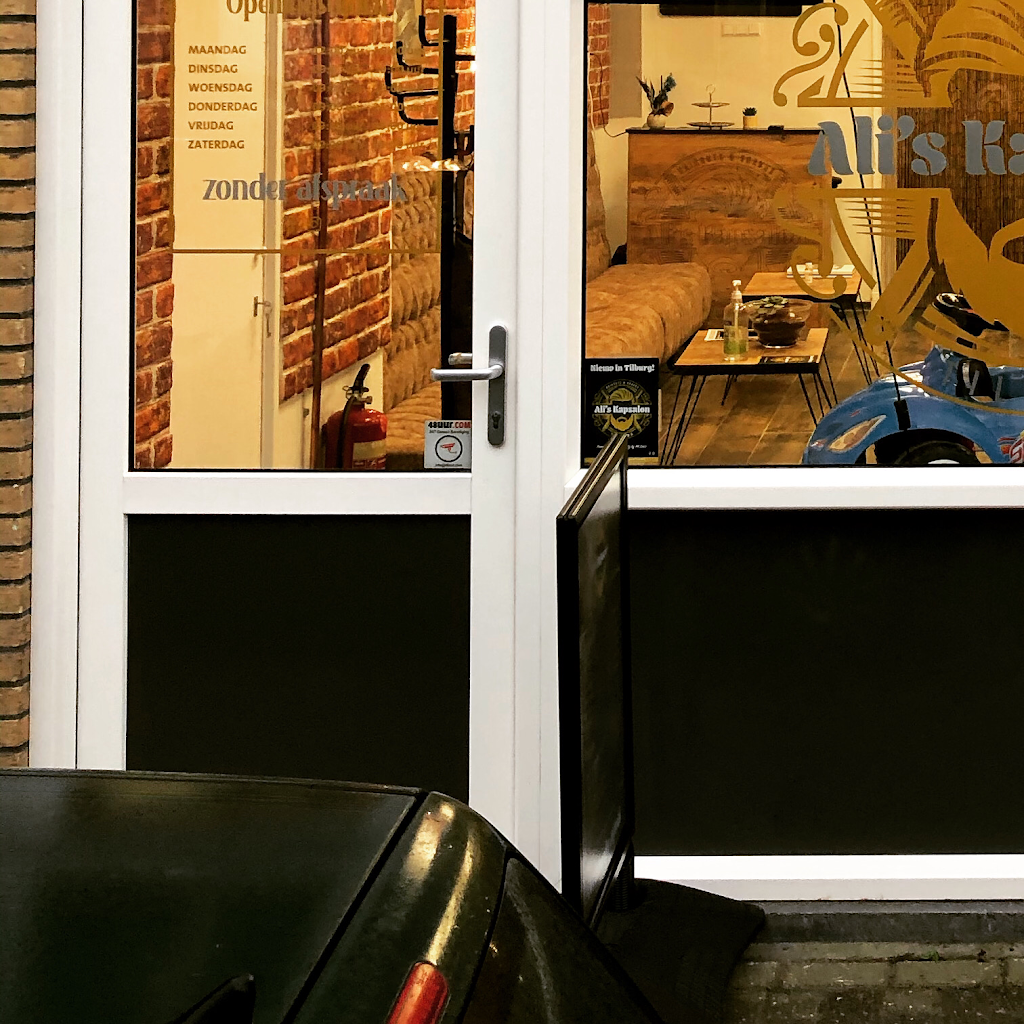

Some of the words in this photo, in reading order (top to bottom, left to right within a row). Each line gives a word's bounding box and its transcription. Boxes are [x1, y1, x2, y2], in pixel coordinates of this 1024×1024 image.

[188, 45, 247, 54] MAANDAG
[188, 64, 238, 73] DINSDAG
[188, 83, 253, 92] WOENSDAG
[188, 102, 258, 111] DONDERDAG
[187, 121, 234, 130] VRIJDAG
[187, 140, 245, 149] ZATERDAG
[807, 114, 948, 176] Ali's
[202, 173, 287, 201] zonder
[615, 364, 623, 372] in
[624, 364, 655, 373] Tilburg!
[594, 405, 612, 414] Ali's
[613, 405, 651, 415] Kapsalon
